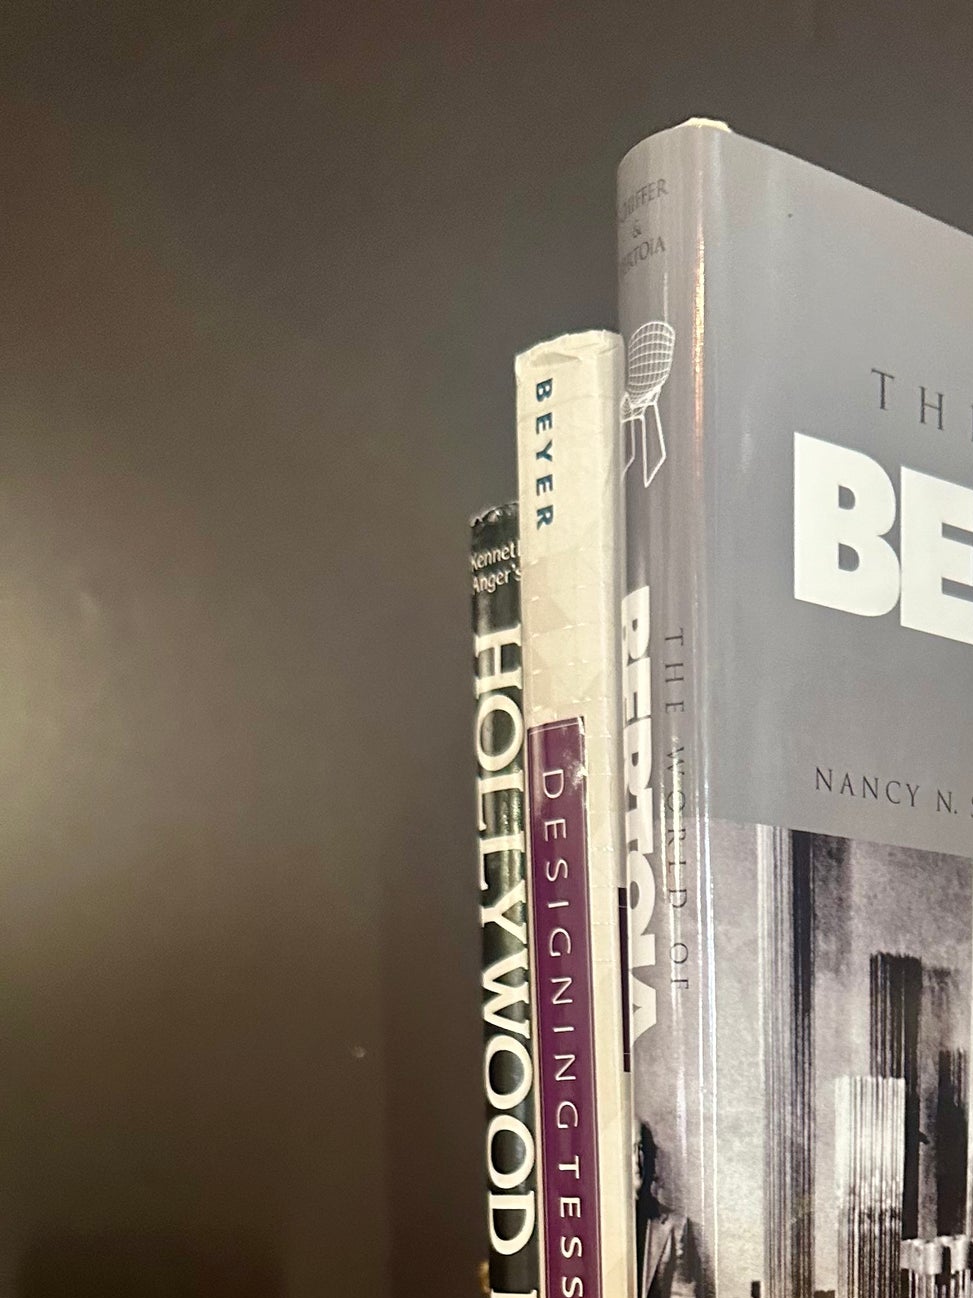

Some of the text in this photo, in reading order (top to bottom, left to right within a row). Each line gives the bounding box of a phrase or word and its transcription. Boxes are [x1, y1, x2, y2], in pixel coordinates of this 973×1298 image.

[472, 563, 521, 595] Anger's
[536, 378, 553, 530] BEYER
[665, 627, 690, 990] THE WORLD OF
[815, 766, 920, 808] NANCY
[936, 789, 958, 815] N.
[474, 623, 536, 1256] HOLLYWOOD
[541, 767, 580, 1130] DESIGNING
